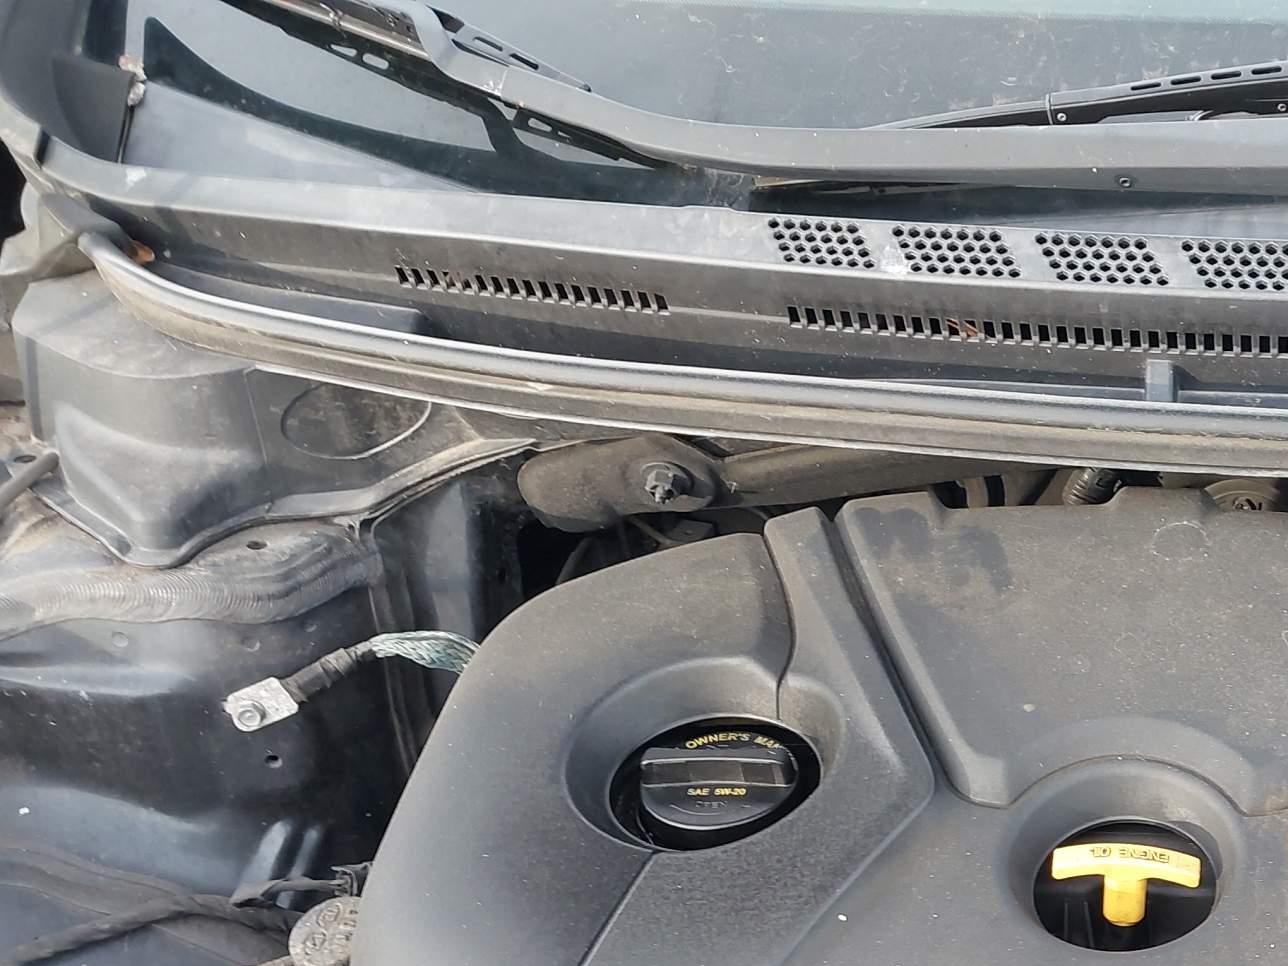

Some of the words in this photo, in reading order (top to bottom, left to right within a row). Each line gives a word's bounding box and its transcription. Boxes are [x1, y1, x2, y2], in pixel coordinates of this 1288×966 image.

[686, 732, 751, 749] OWNER'S
[687, 787, 710, 797] SAE
[714, 788, 746, 796] 5W-20
